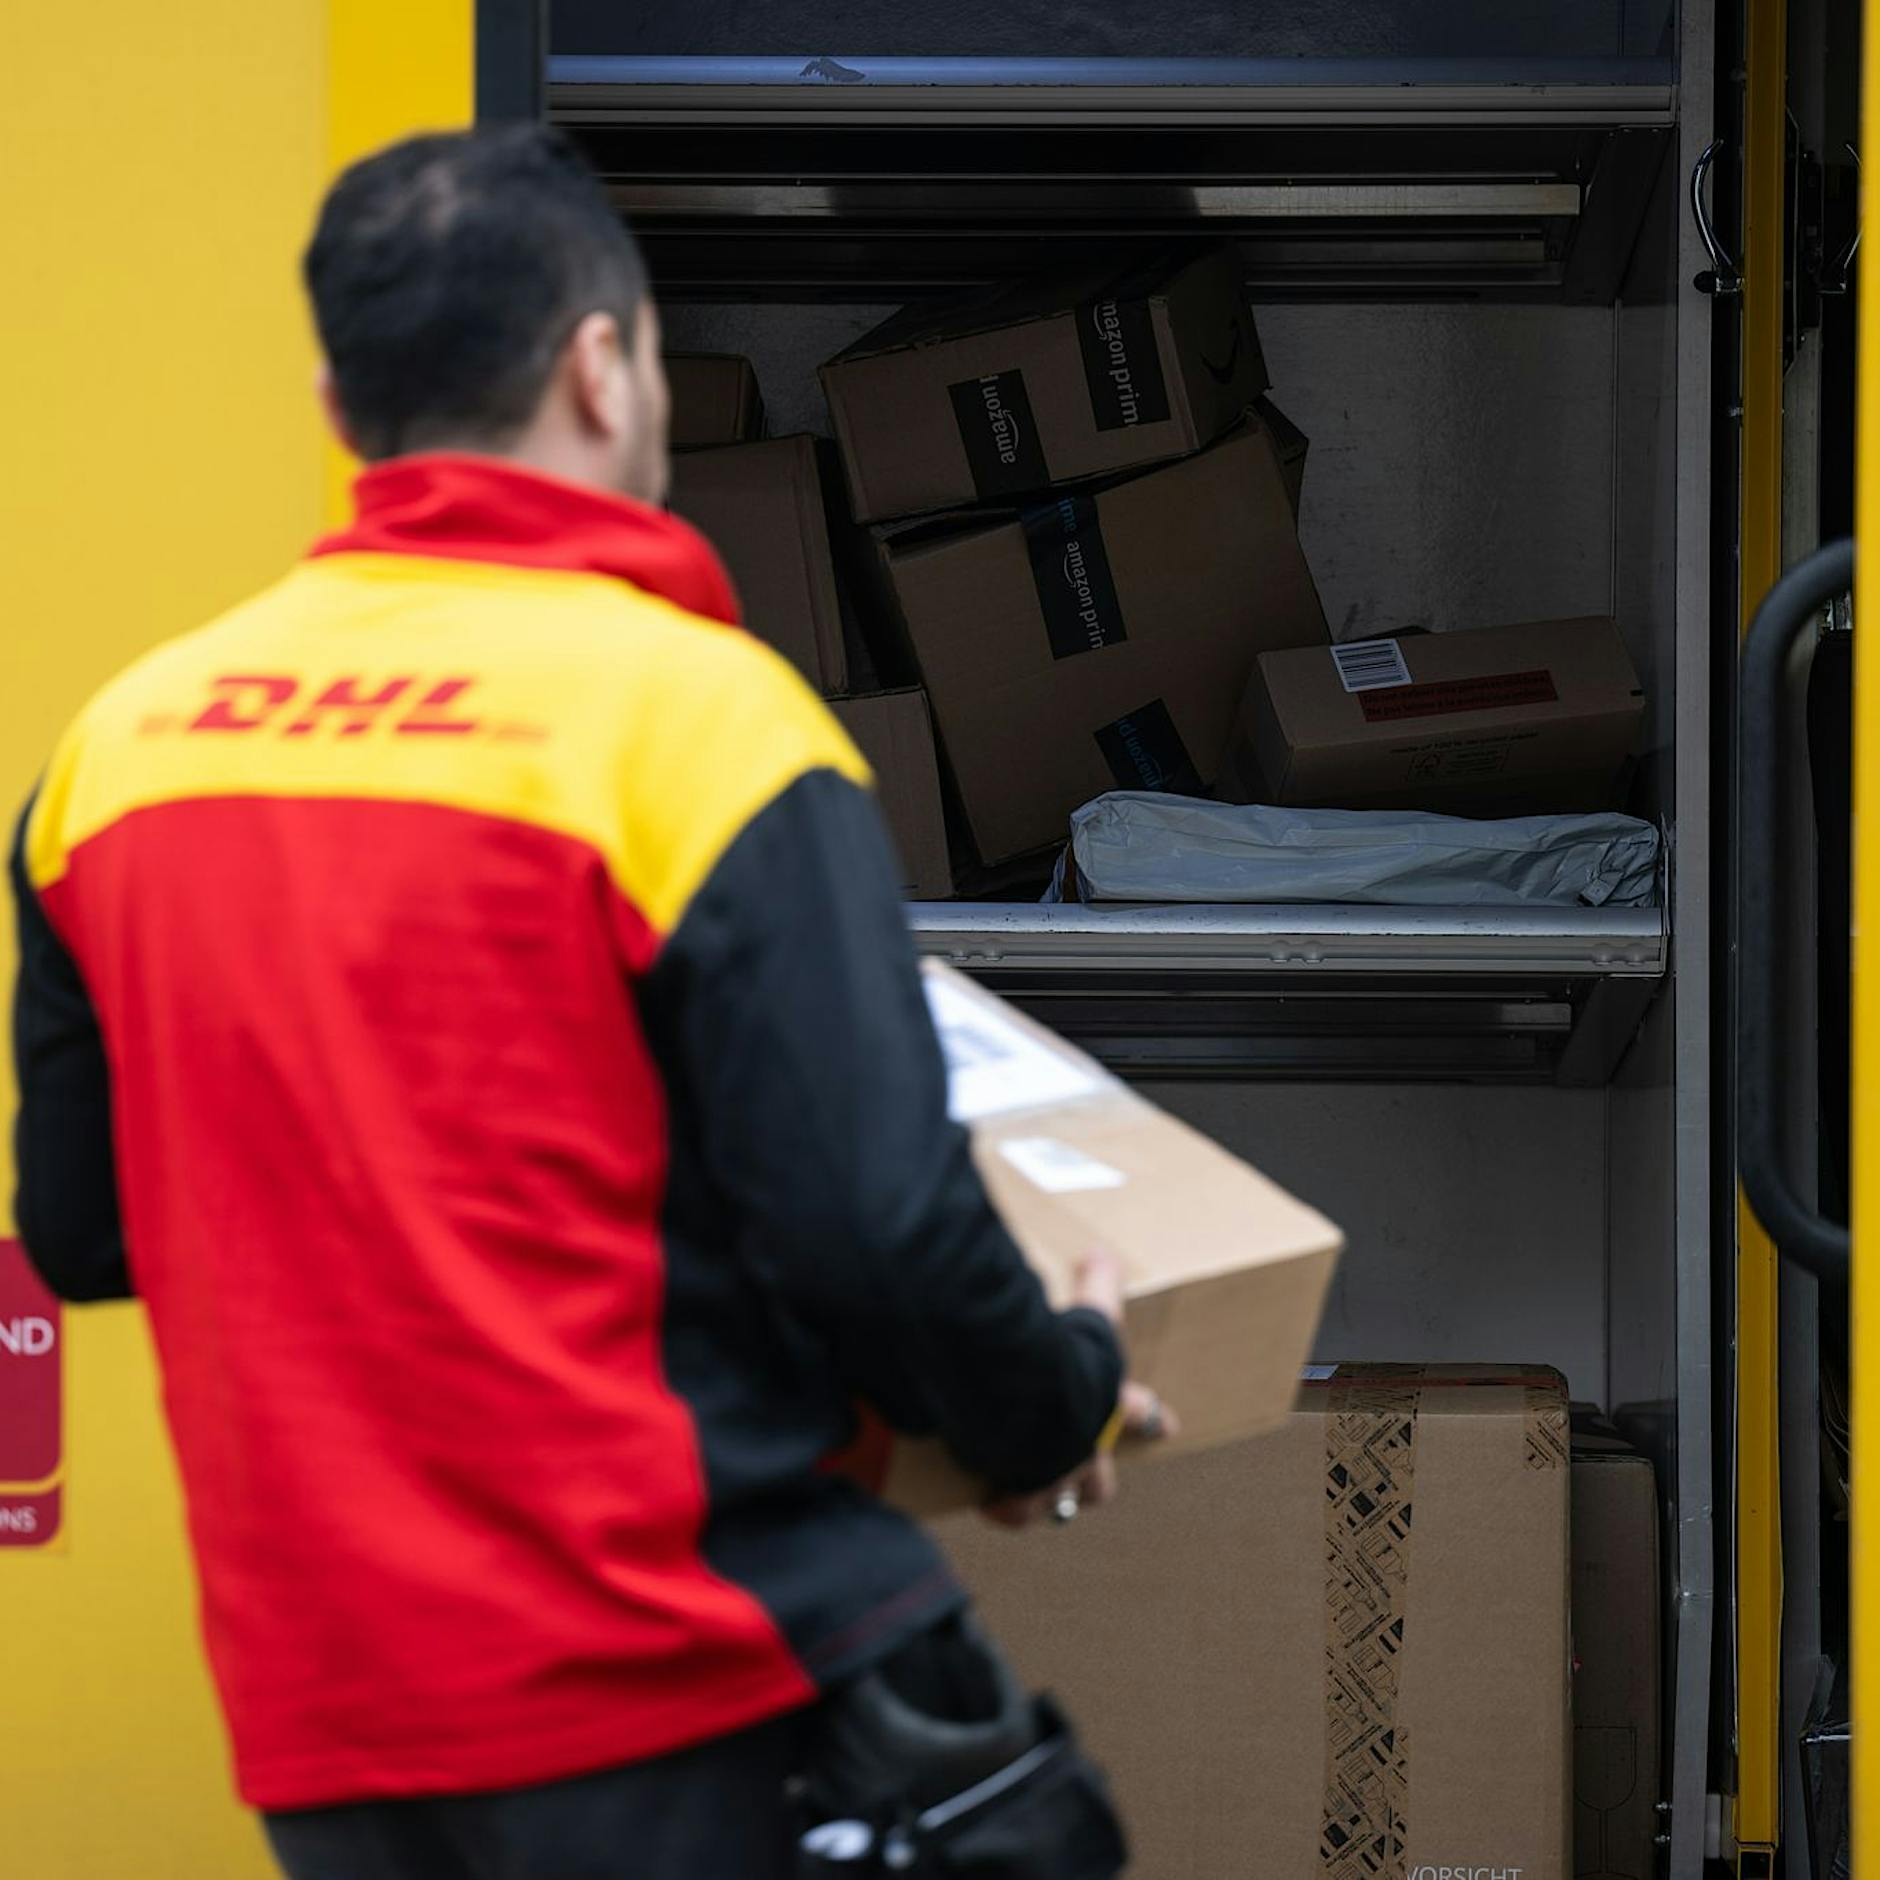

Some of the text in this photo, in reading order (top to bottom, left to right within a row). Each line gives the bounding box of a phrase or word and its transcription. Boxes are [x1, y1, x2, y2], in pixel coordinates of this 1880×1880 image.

[982, 384, 1019, 465] amazon
[1064, 540, 1094, 608] amazon
[187, 676, 476, 735] DHL
[0, 1316, 54, 1355] ND
